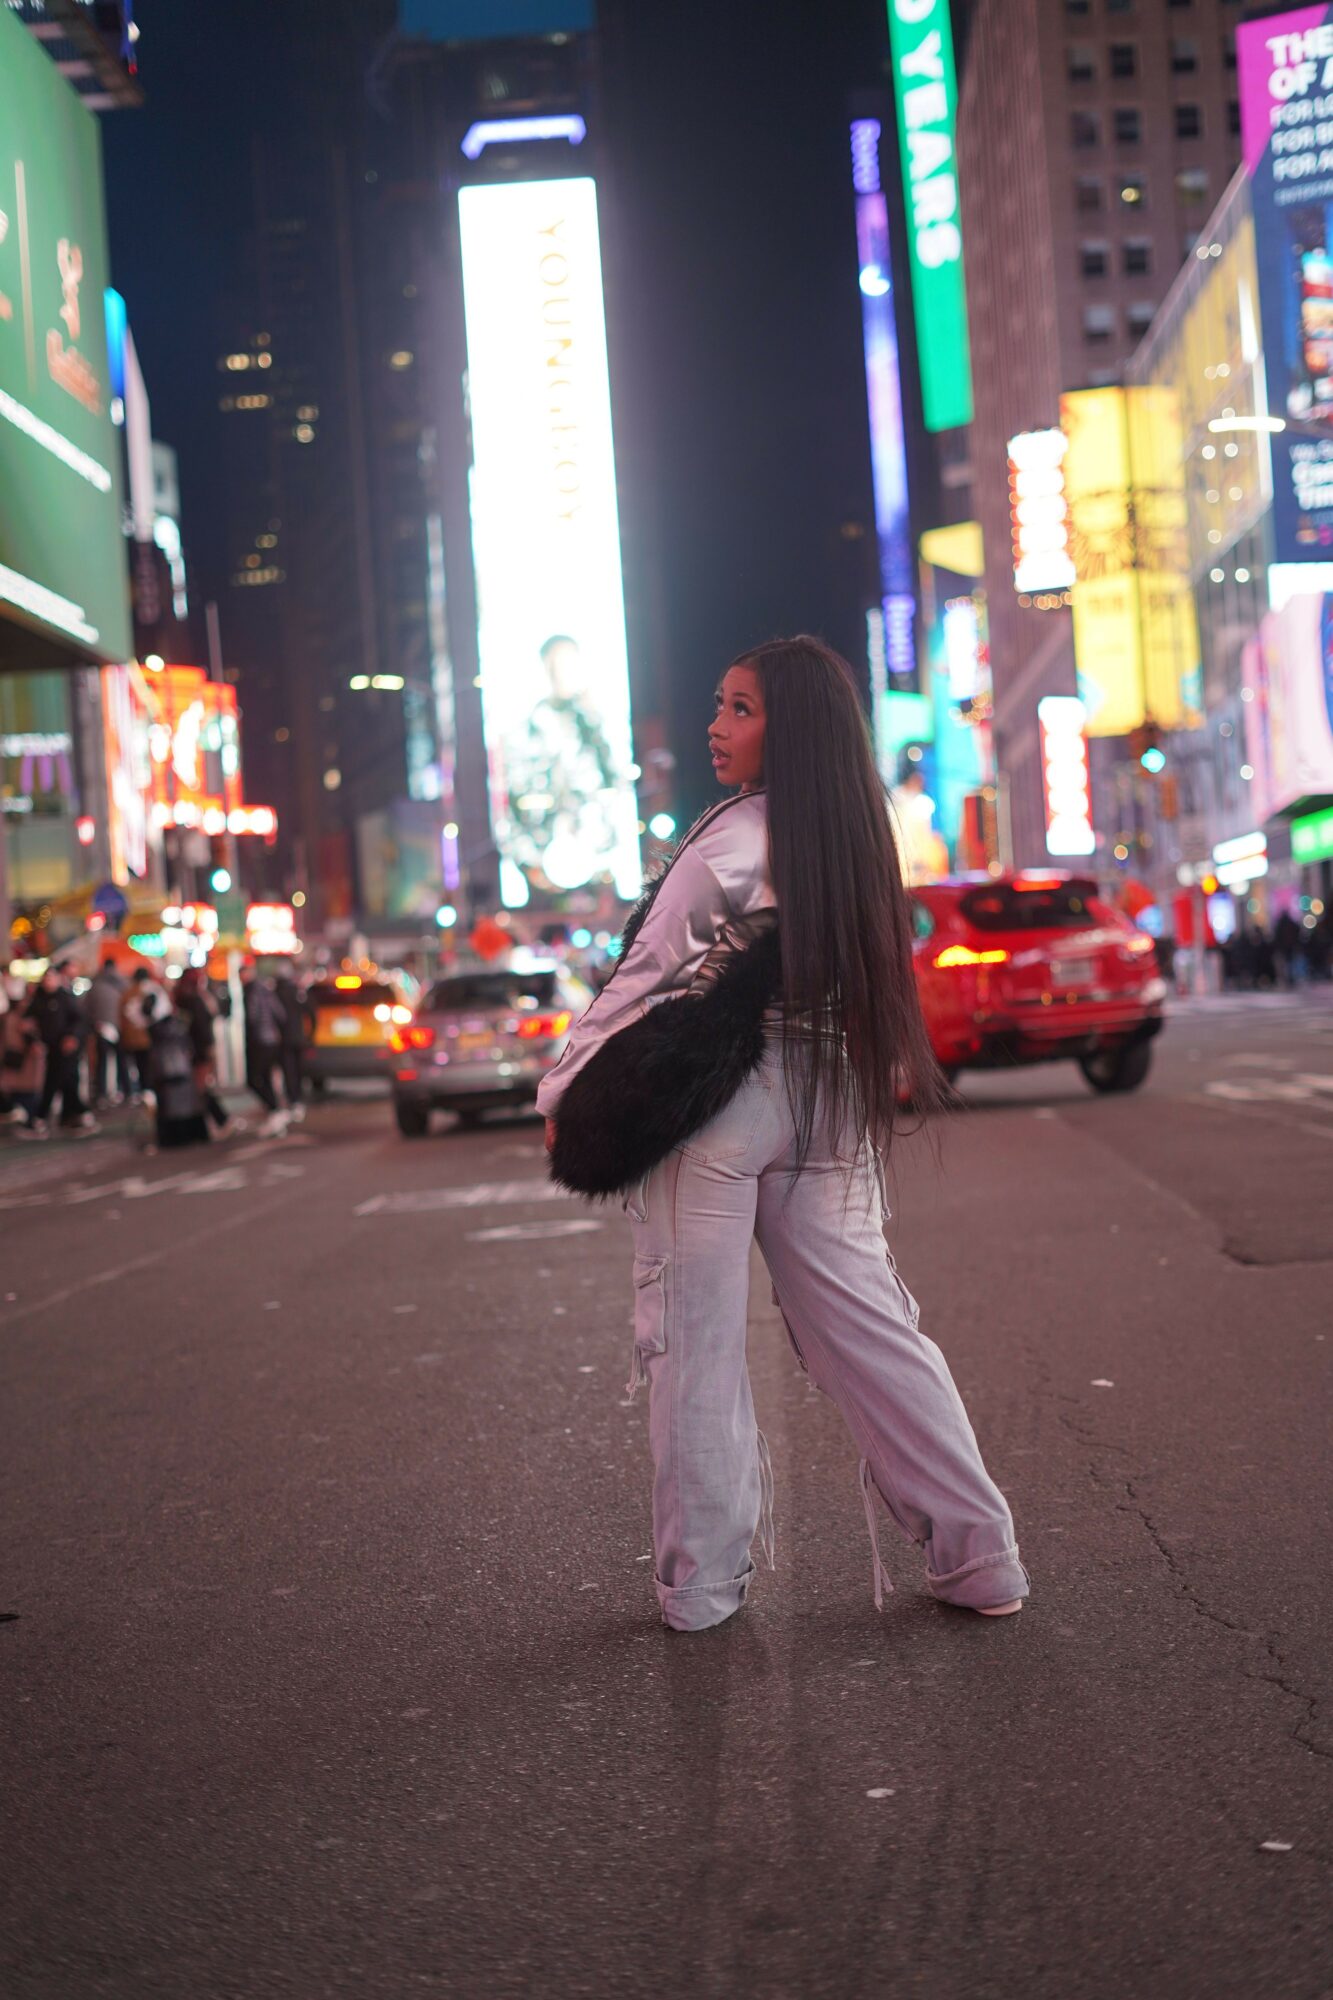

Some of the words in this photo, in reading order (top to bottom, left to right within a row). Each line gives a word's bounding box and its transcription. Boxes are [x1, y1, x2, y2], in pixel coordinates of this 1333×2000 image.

[1268, 61, 1317, 100] OF
[1269, 98, 1314, 128] FOR
[900, 29, 962, 269] YEARS
[1271, 125, 1315, 155] FOR
[1272, 152, 1317, 182] FOR
